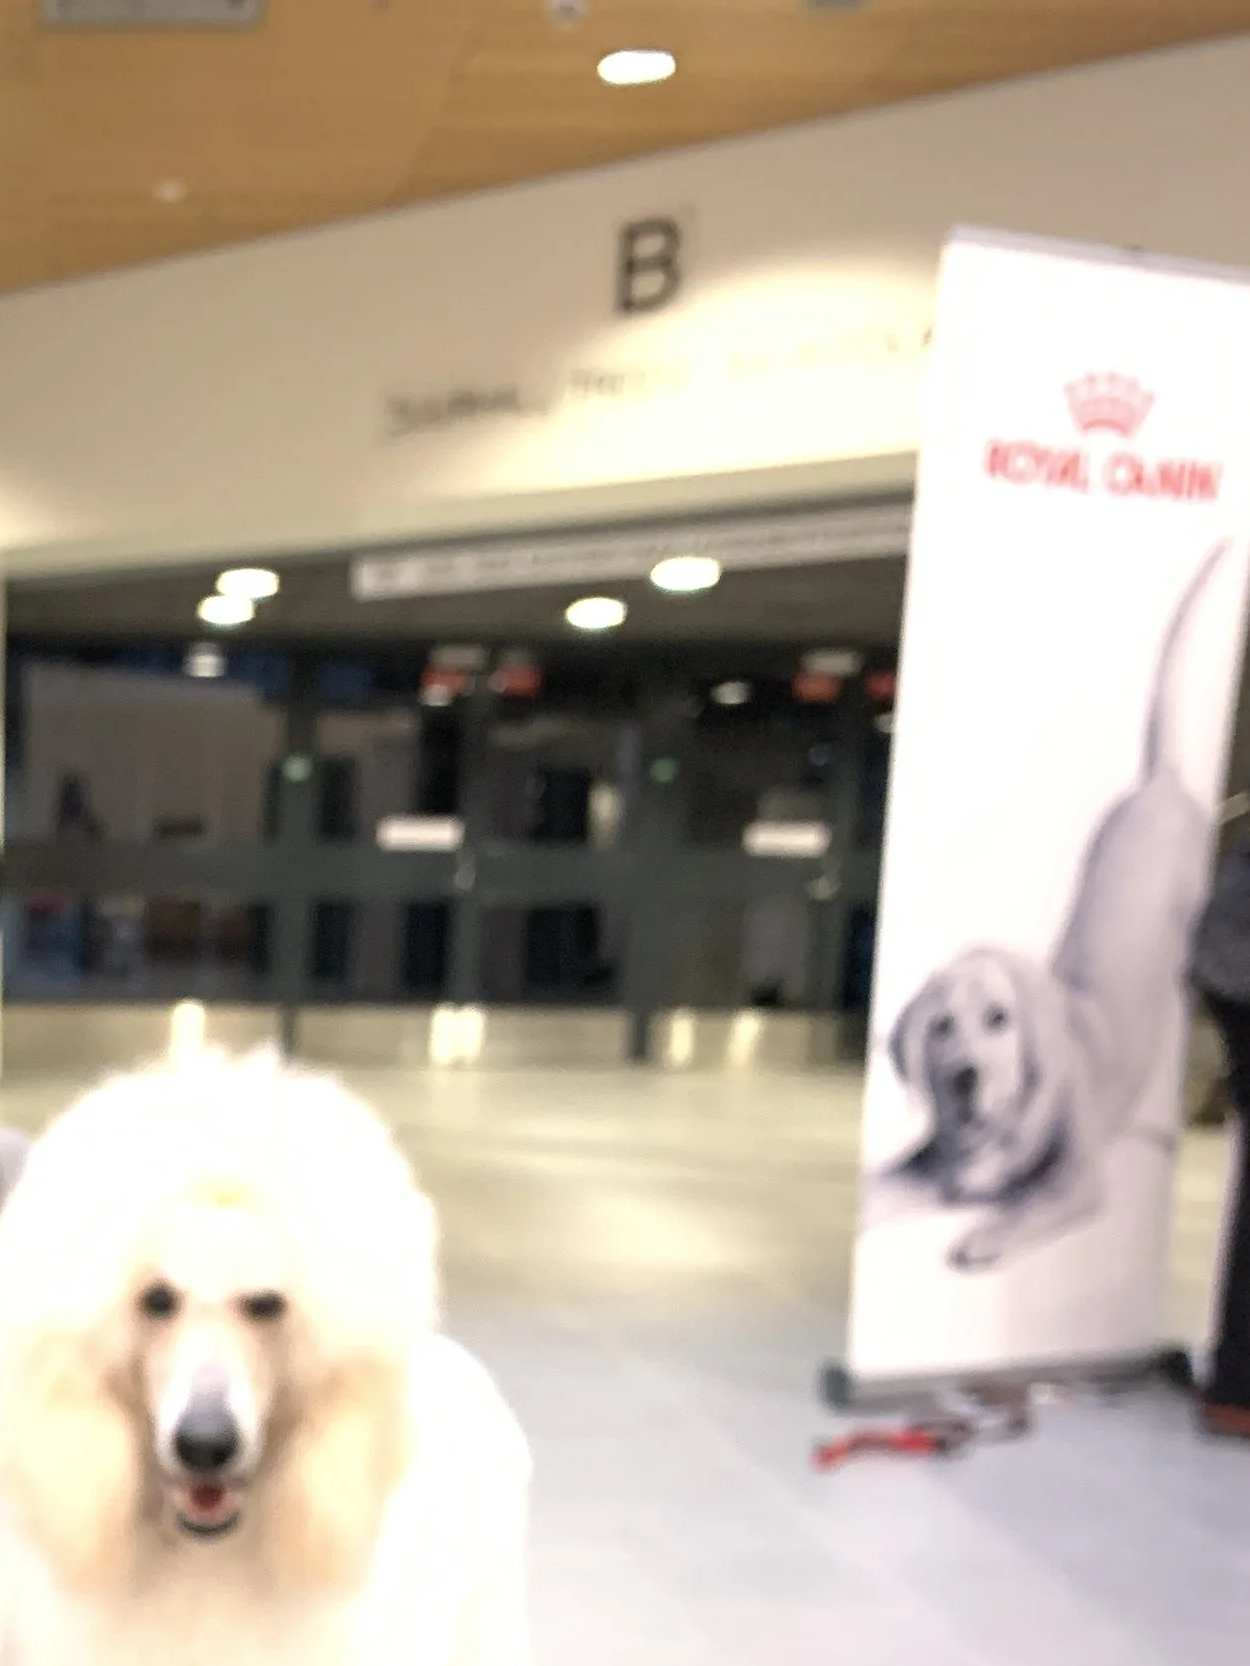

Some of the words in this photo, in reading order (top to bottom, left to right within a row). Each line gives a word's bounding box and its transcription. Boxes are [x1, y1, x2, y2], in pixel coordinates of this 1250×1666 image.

[614, 216, 681, 314] B
[984, 440, 1089, 493] ROYAL
[1103, 453, 1220, 504] CANIN
